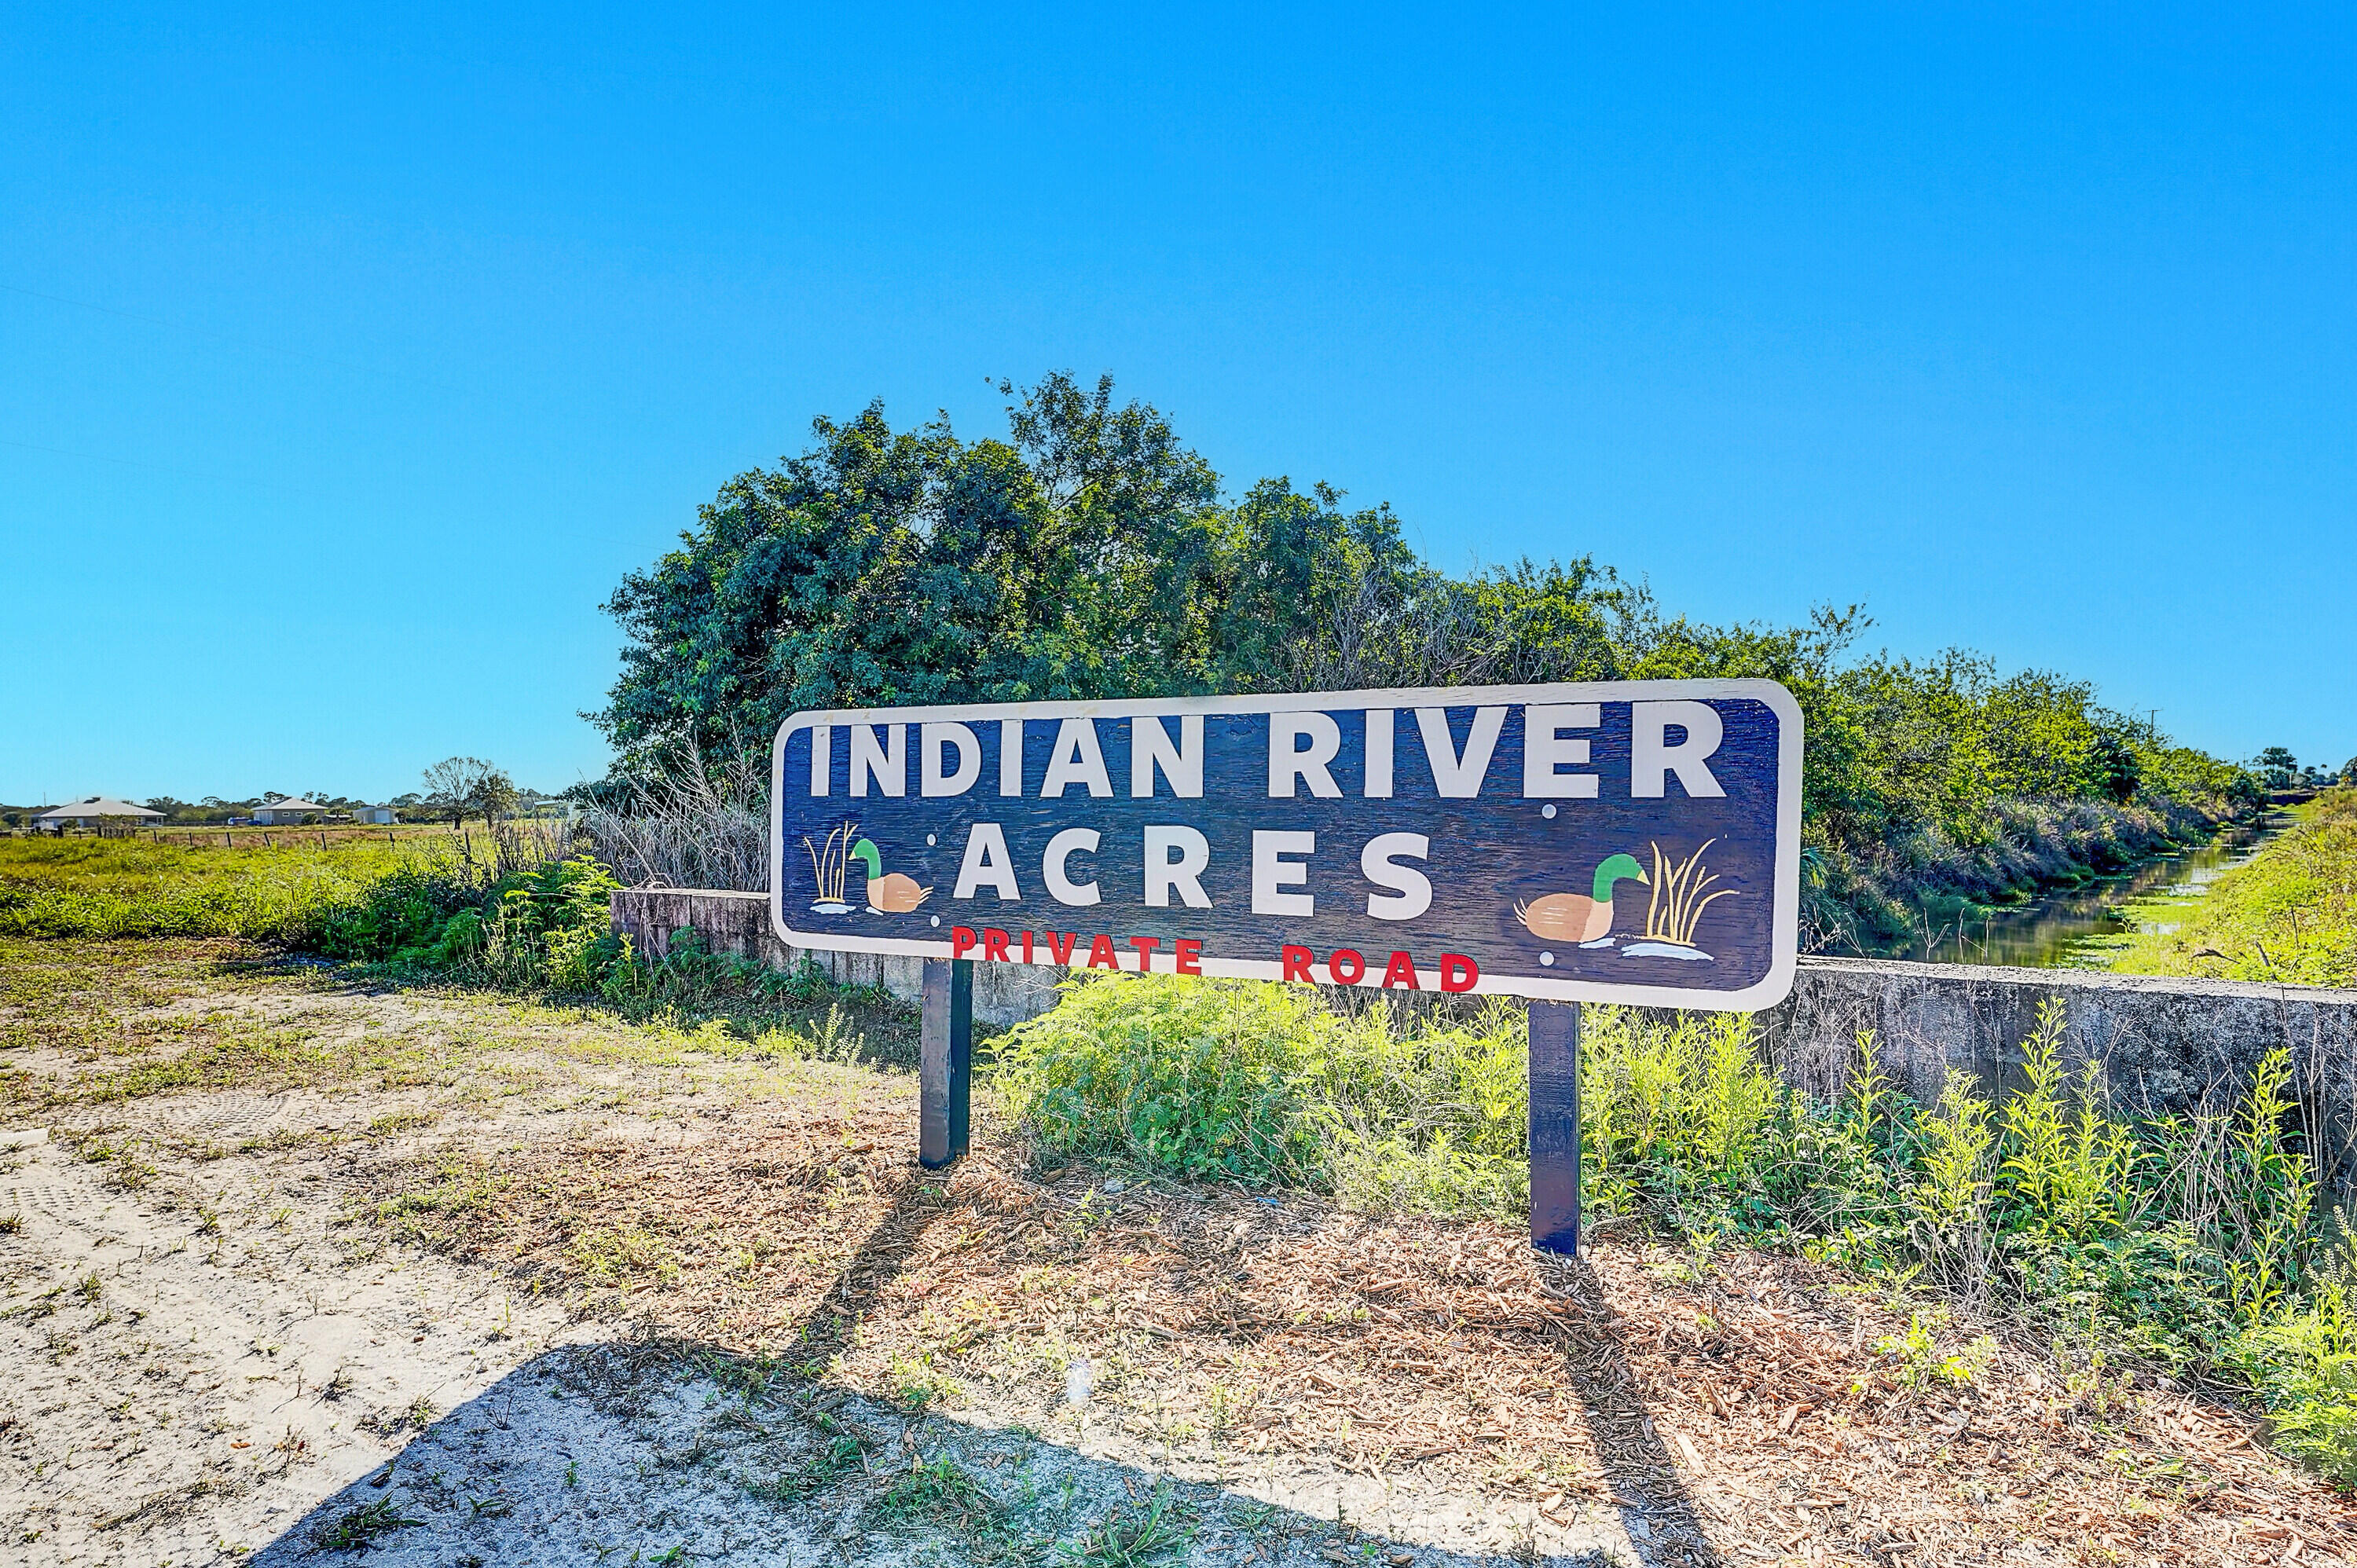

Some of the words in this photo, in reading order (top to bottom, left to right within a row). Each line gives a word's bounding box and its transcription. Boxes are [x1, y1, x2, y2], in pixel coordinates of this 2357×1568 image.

[811, 715, 1204, 798] INDIAN
[1268, 701, 1727, 798] RIVER
[952, 822, 1432, 921] ACRES
[952, 926, 1202, 976] PRIVATE
[1282, 944, 1479, 994] ROAD
